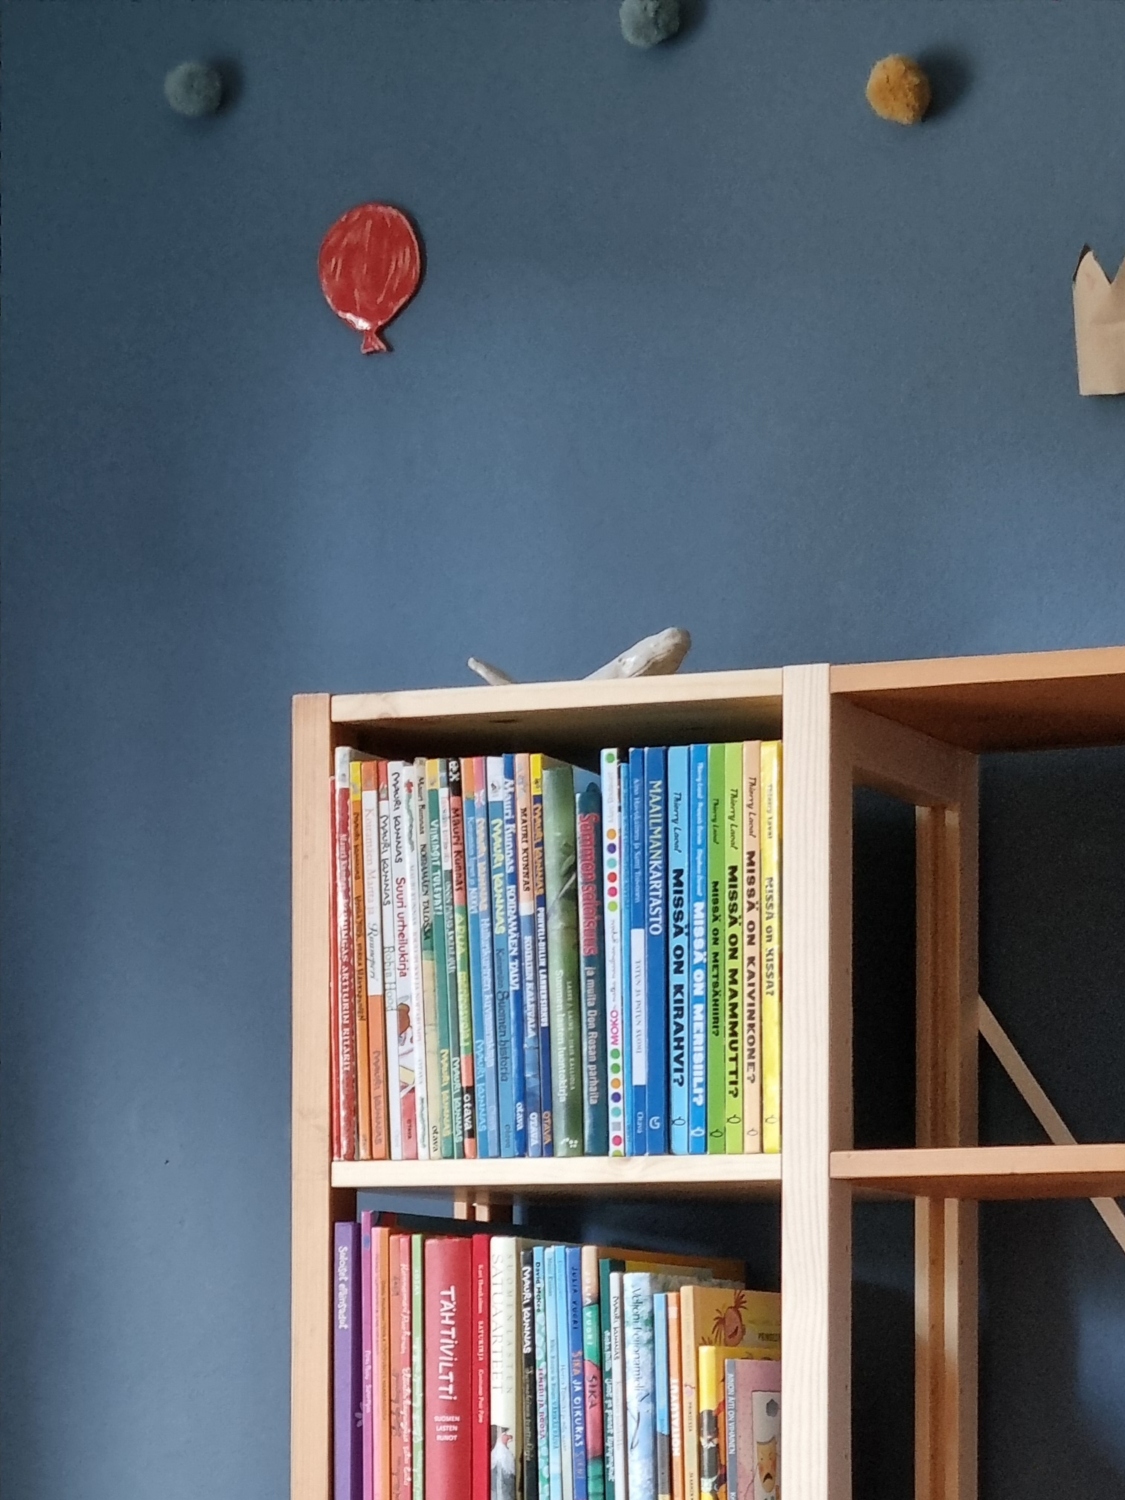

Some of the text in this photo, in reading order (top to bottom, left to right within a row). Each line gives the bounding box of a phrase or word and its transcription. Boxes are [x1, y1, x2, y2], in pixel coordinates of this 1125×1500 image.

[520, 807, 529, 844] MAURI
[711, 798, 720, 824] Thierry
[380, 815, 391, 853] MAURI
[490, 818, 504, 869] MAURI
[391, 772, 409, 978] MAURI KUNNAS Suuri urheilukirja
[521, 848, 530, 892] KUNNAS
[648, 780, 663, 935] MAAILMANKARTASTO
[381, 858, 392, 906] KUNNAS
[492, 873, 507, 935] KUNNAS
[711, 881, 722, 923] MISSÄ
[672, 792, 689, 1087] Thierry Laval MISSÄ ON KIRAHVI?
[692, 901, 707, 965] MISSÄ
[712, 927, 720, 945] ON
[728, 788, 742, 1098] Thierry Laval MISSÄ ON MAMMUTTI?
[746, 777, 759, 1084] Thierry Laval MISSÄ ON KAIVINKONE?
[452, 807, 474, 1131] Mauri Kunnas otava
[585, 967, 597, 977] ja
[692, 968, 705, 997] ON
[764, 948, 775, 997] KISSA?
[554, 969, 565, 1010] Suomen
[587, 979, 597, 1007] muita
[711, 952, 722, 1037] METSÄHIIRI?
[496, 990, 510, 1037] Suomen
[588, 1009, 598, 1029] Don
[498, 1039, 511, 1082] historia
[588, 1031, 599, 1061] Rosan
[691, 1003, 705, 1106] MERISIILI?
[556, 1047, 568, 1103] luontokirja
[586, 1064, 600, 1105] parhaita
[515, 1102, 525, 1131] otava
[529, 1112, 539, 1147] OTAVA
[542, 1110, 551, 1145] OTAVA
[635, 1111, 644, 1134] Otava
[431, 1125, 439, 1152] otava
[337, 1246, 349, 1281] Suloiset
[521, 1266, 532, 1304] MAURI
[535, 1287, 543, 1313] McKee
[585, 1271, 593, 1304] JULIA
[491, 1254, 503, 1394] SATUAARTEET
[506, 1254, 514, 1394] SUOMEN LASTEN
[571, 1300, 579, 1330] VUORI
[631, 1288, 643, 1323] Veljeni
[438, 1285, 459, 1401] TÄHTIVILTTI
[522, 1307, 532, 1354] KUNNAS
[585, 1311, 594, 1345] VUORI
[572, 1350, 582, 1377] SIKA
[572, 1379, 582, 1391] JA
[585, 1375, 599, 1409] SIKA
[727, 1373, 735, 1395] AINON
[573, 1397, 583, 1448] OIKUKAS
[670, 1379, 681, 1456] NOITALUVUT
[728, 1410, 735, 1420] ON
[728, 1422, 736, 1454] VIHAINEN
